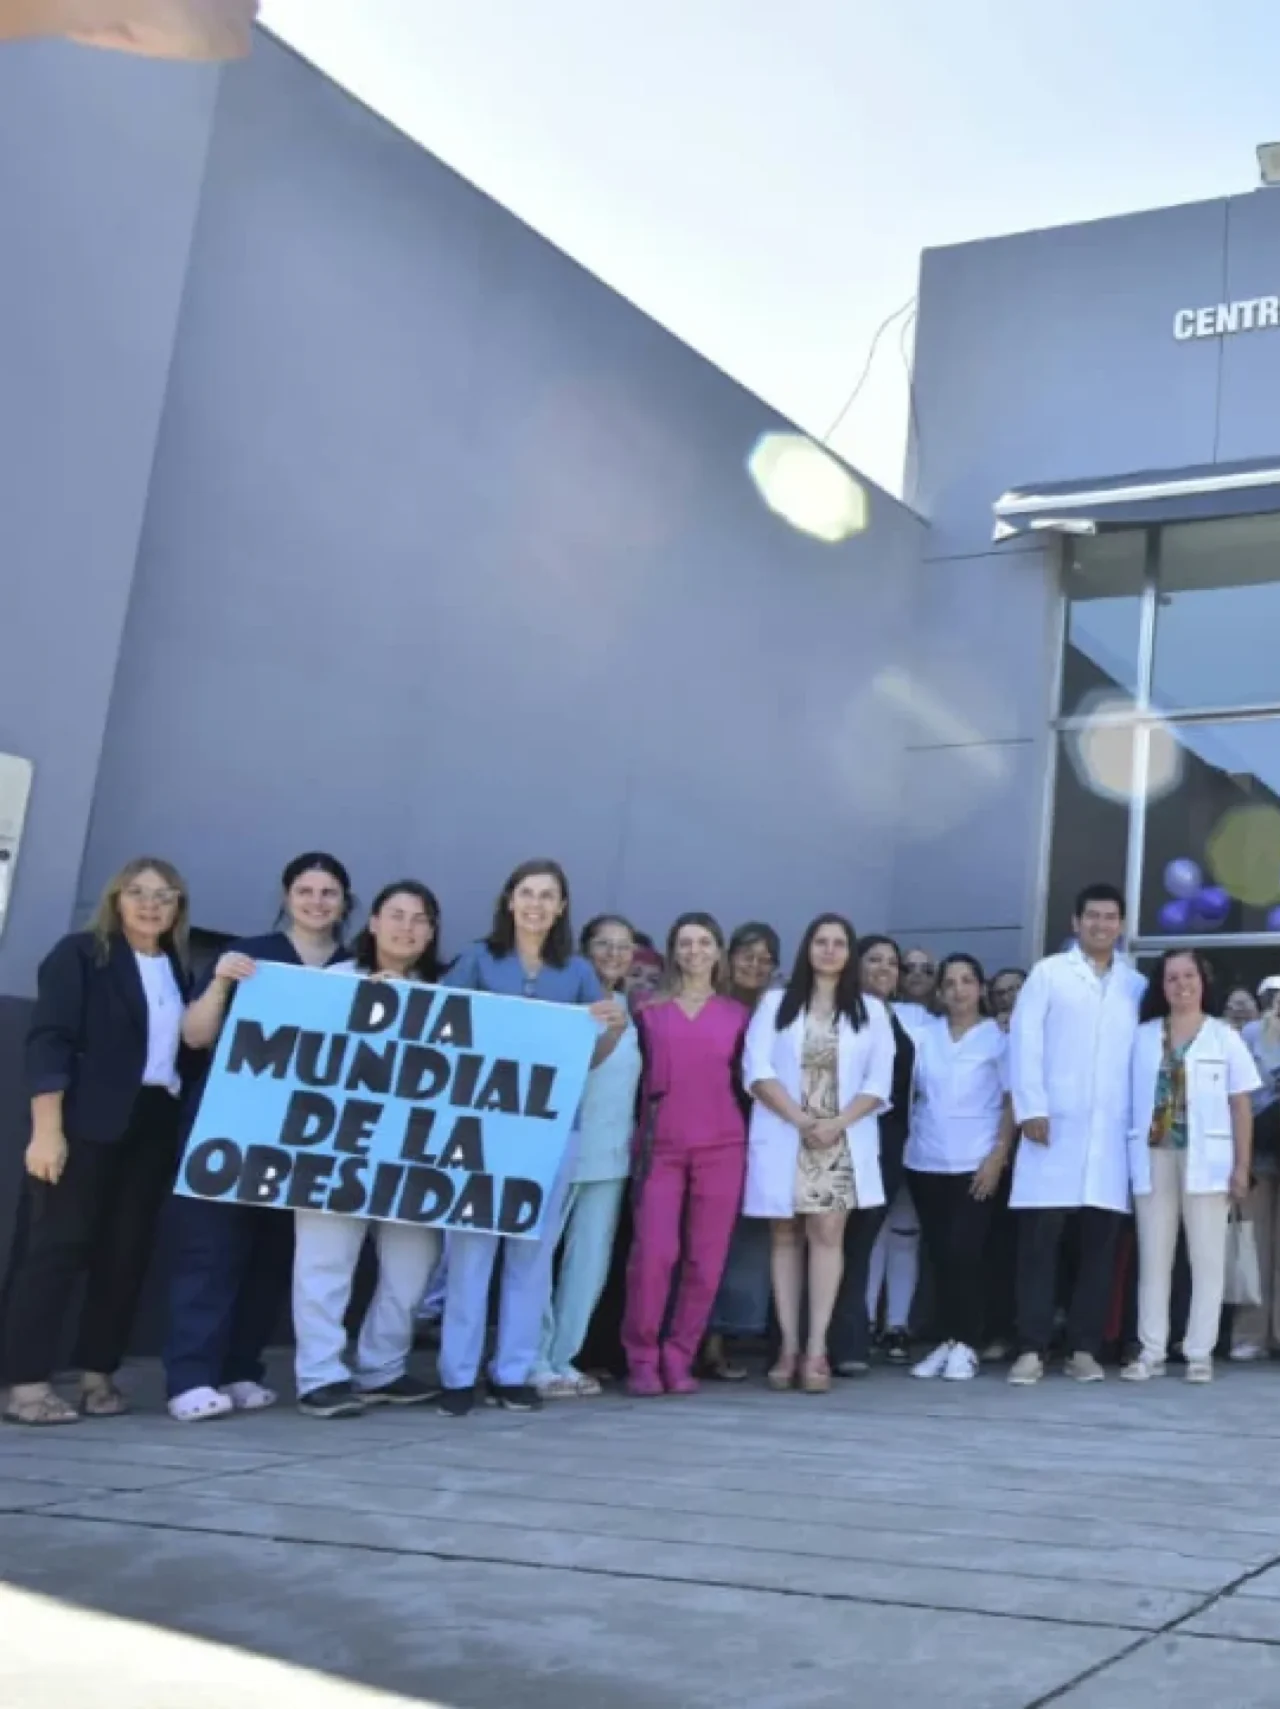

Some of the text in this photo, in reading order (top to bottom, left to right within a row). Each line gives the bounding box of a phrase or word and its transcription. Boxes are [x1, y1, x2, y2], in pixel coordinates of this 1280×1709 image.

[347, 979, 474, 1048] DIA
[225, 1018, 558, 1120] MUNDIAL
[280, 1089, 486, 1172] DE LA
[185, 1137, 544, 1234] OBESIDAD
